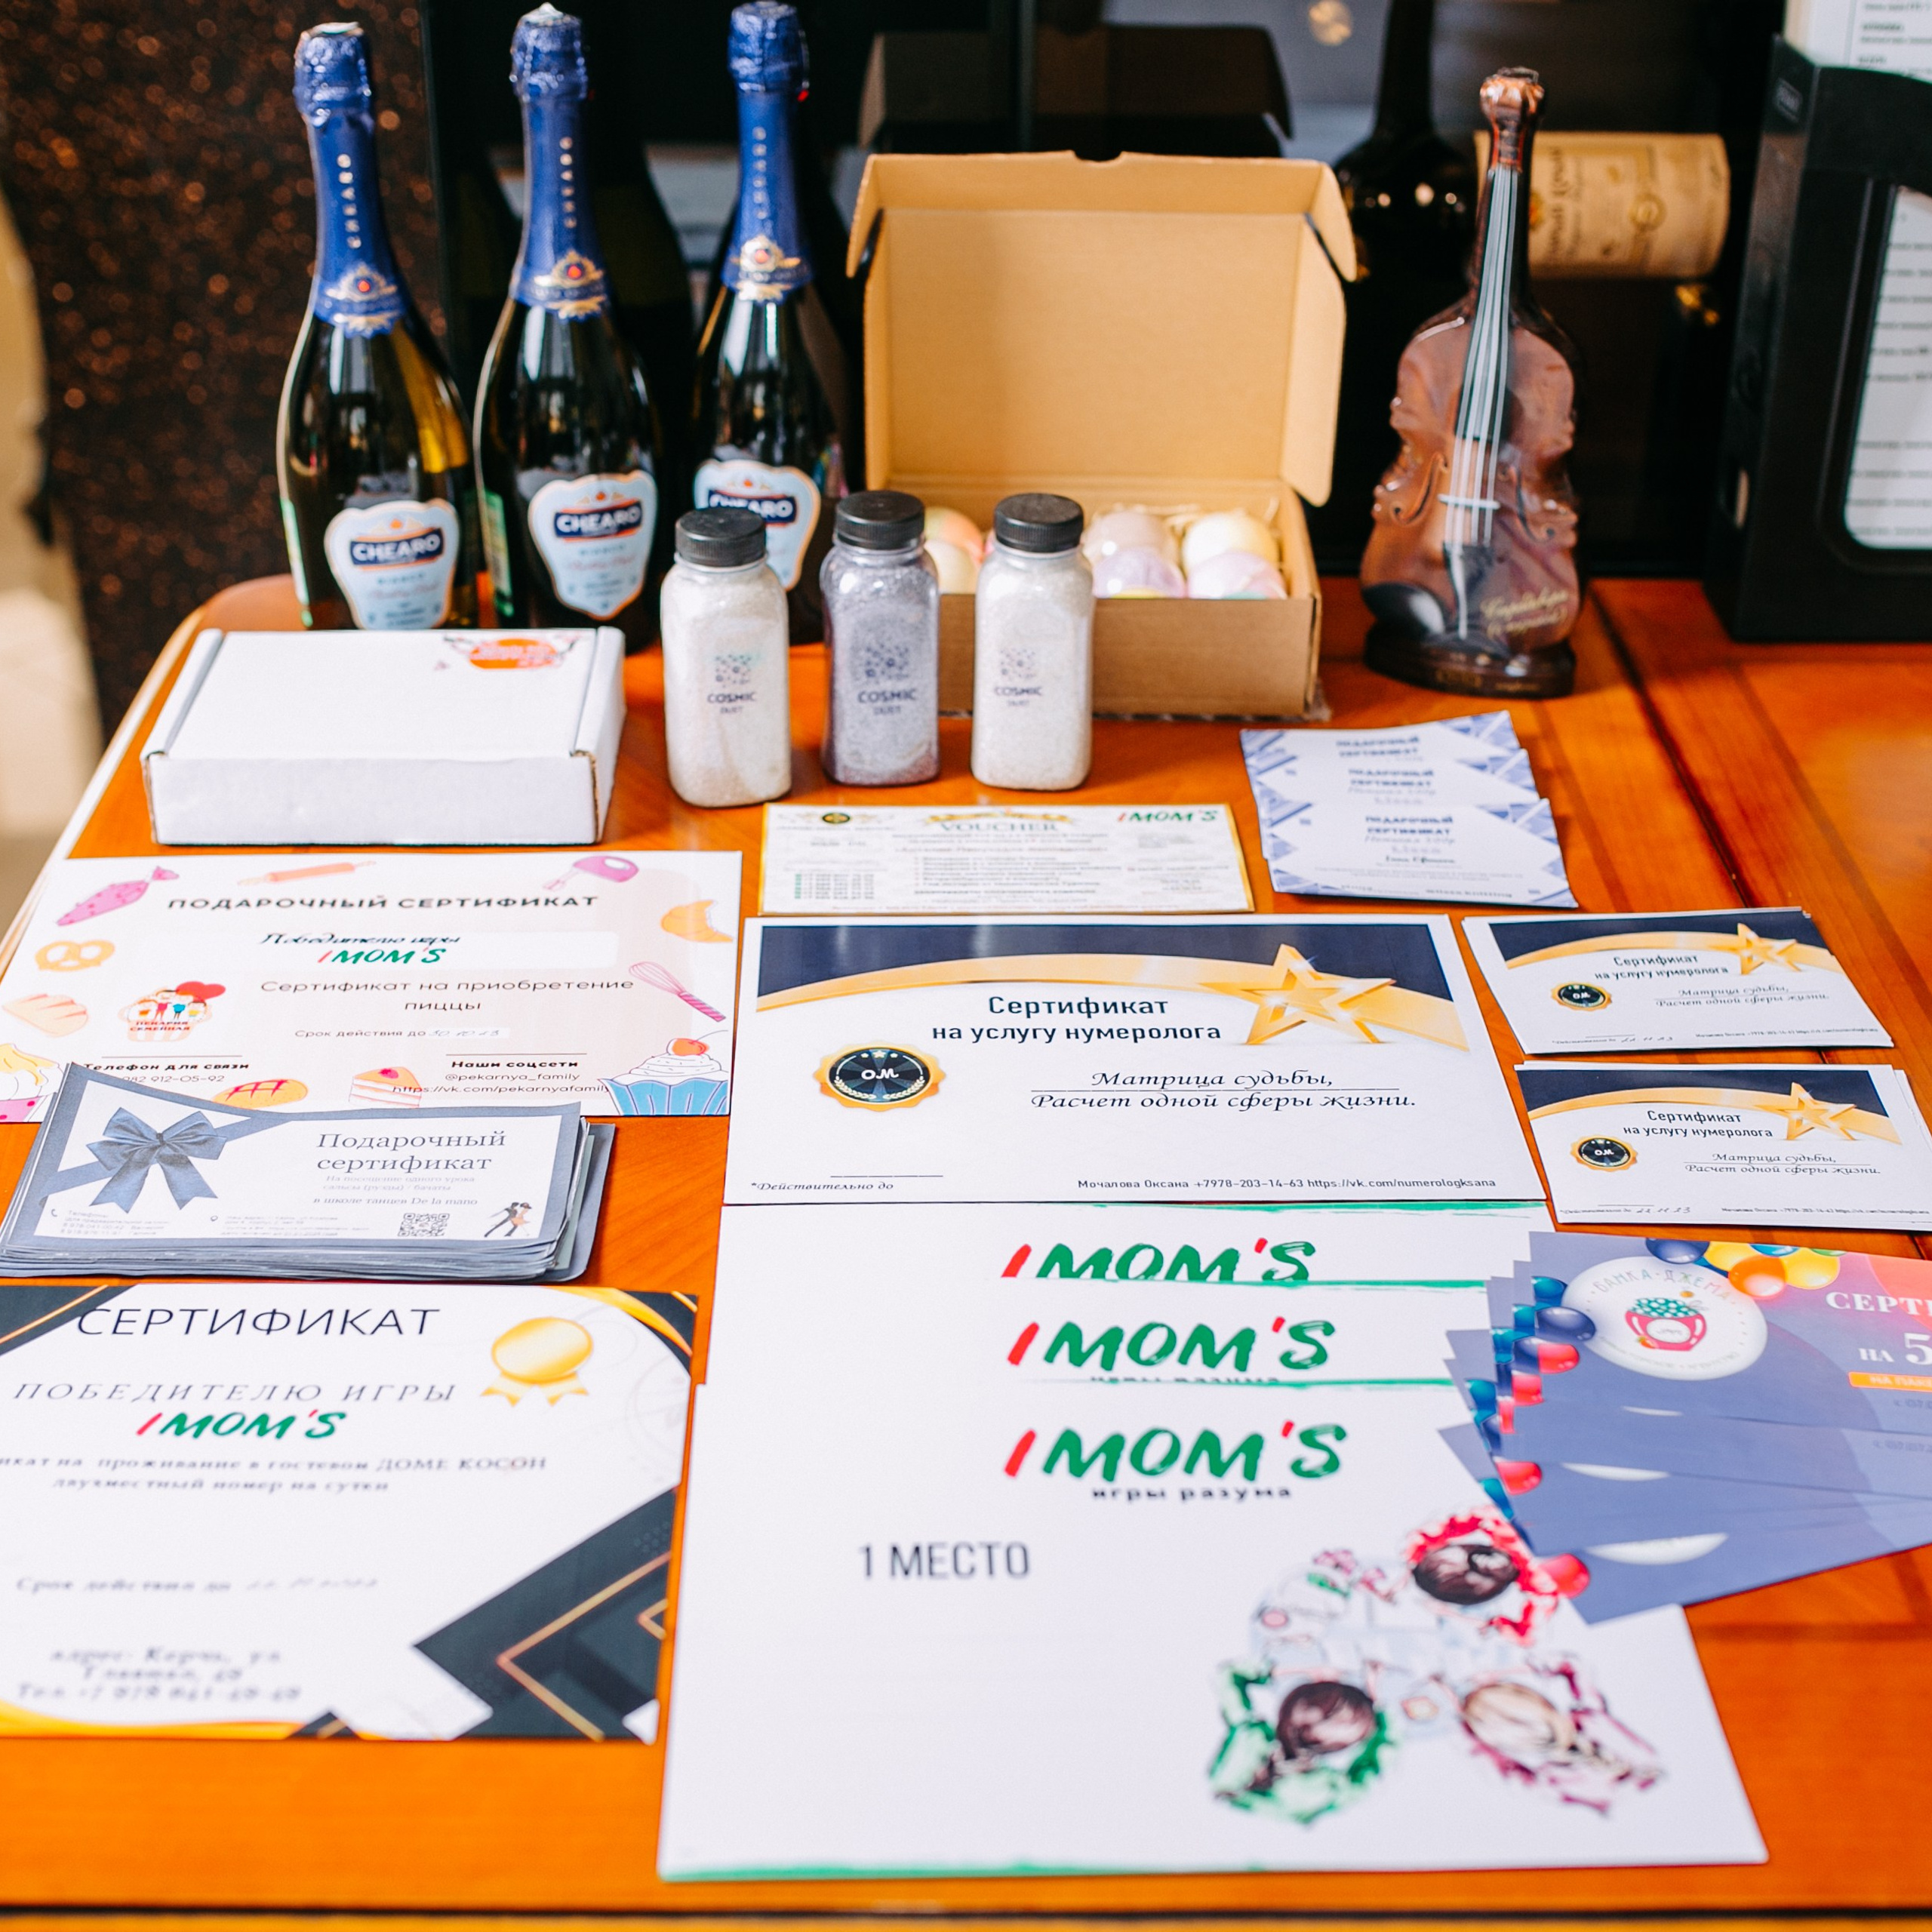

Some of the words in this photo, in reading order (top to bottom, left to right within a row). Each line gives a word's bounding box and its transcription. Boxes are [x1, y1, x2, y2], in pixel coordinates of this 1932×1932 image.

[555, 506, 641, 534] CHEARO
[352, 533, 441, 562] CHEARO
[707, 690, 756, 703] COSMIC
[857, 688, 917, 703] COSMIC
[994, 685, 1043, 697] COSMIC
[940, 822, 1059, 832] VOUCHER
[168, 895, 388, 910] ПОДАРОЧНЫЙ
[398, 896, 598, 909] СЕРТИФИКАТ
[260, 932, 406, 945] Победителю
[1614, 955, 1699, 967] Сертификат
[1612, 970, 1653, 980] услугу
[1656, 966, 1728, 978] нумеролога
[260, 980, 411, 993] Сертификат
[419, 981, 448, 991] на
[457, 979, 635, 993] приобретение
[1678, 988, 1739, 999] Матрица
[1706, 996, 1740, 1004] одной
[1745, 995, 1783, 1005] сферы
[405, 1002, 481, 1011] пиццы
[988, 996, 1168, 1019] Сертификат
[295, 1029, 331, 1038] Срок
[335, 1029, 402, 1038] действия
[932, 1026, 962, 1040] на
[971, 1026, 1057, 1044] услугу
[1066, 1026, 1221, 1044] нумеролога
[83, 1063, 161, 1071] Телефон
[506, 1061, 579, 1070] соцсети
[151, 1075, 225, 1083] 912-05-92
[445, 1072, 580, 1081] @pekarnya_family
[1092, 1072, 1225, 1090] Матрица
[1234, 1069, 1333, 1089] судьбы,
[1031, 1094, 1131, 1109] Расчет
[1140, 1094, 1220, 1109] одной
[1228, 1093, 1312, 1112] сферы
[1321, 1094, 1417, 1110] жизни.
[1647, 1110, 1742, 1124] Сертификат
[1643, 1127, 1687, 1137] услугу
[1692, 1128, 1774, 1138] нумеролога
[316, 1130, 507, 1152] Подарочный
[317, 1155, 492, 1174] сертификат
[1712, 1153, 1780, 1164] Матрица
[1785, 1153, 1837, 1164] судьбы,
[1685, 1164, 1737, 1173] Расчет
[1740, 1163, 1780, 1173] одной
[1785, 1164, 1828, 1175] сферы
[1832, 1166, 1881, 1175] жизни.
[878, 1181, 894, 1191] до
[1078, 1180, 1140, 1189] Мочалова
[1144, 1180, 1189, 1189] Оксана
[1194, 1179, 1303, 1189] +7978-203-14-63
[1307, 1179, 1496, 1189] https://vk.com/numerologksana
[411, 1197, 429, 1205] De
[77, 1308, 441, 1336] СЕРТИФИКАТ
[13, 1383, 323, 1403] ПОБЕДИТЕЛЮ
[342, 1383, 457, 1402] ИГРЫ
[97, 1458, 242, 1471] проживание
[376, 1457, 448, 1472] ДОМЕ
[214, 1481, 282, 1494] номер
[325, 1481, 389, 1494] сутки
[1091, 1487, 1167, 1503] игры
[1180, 1487, 1292, 1503] разума
[859, 1543, 874, 1579] 1
[890, 1541, 1030, 1579] МЕСТО
